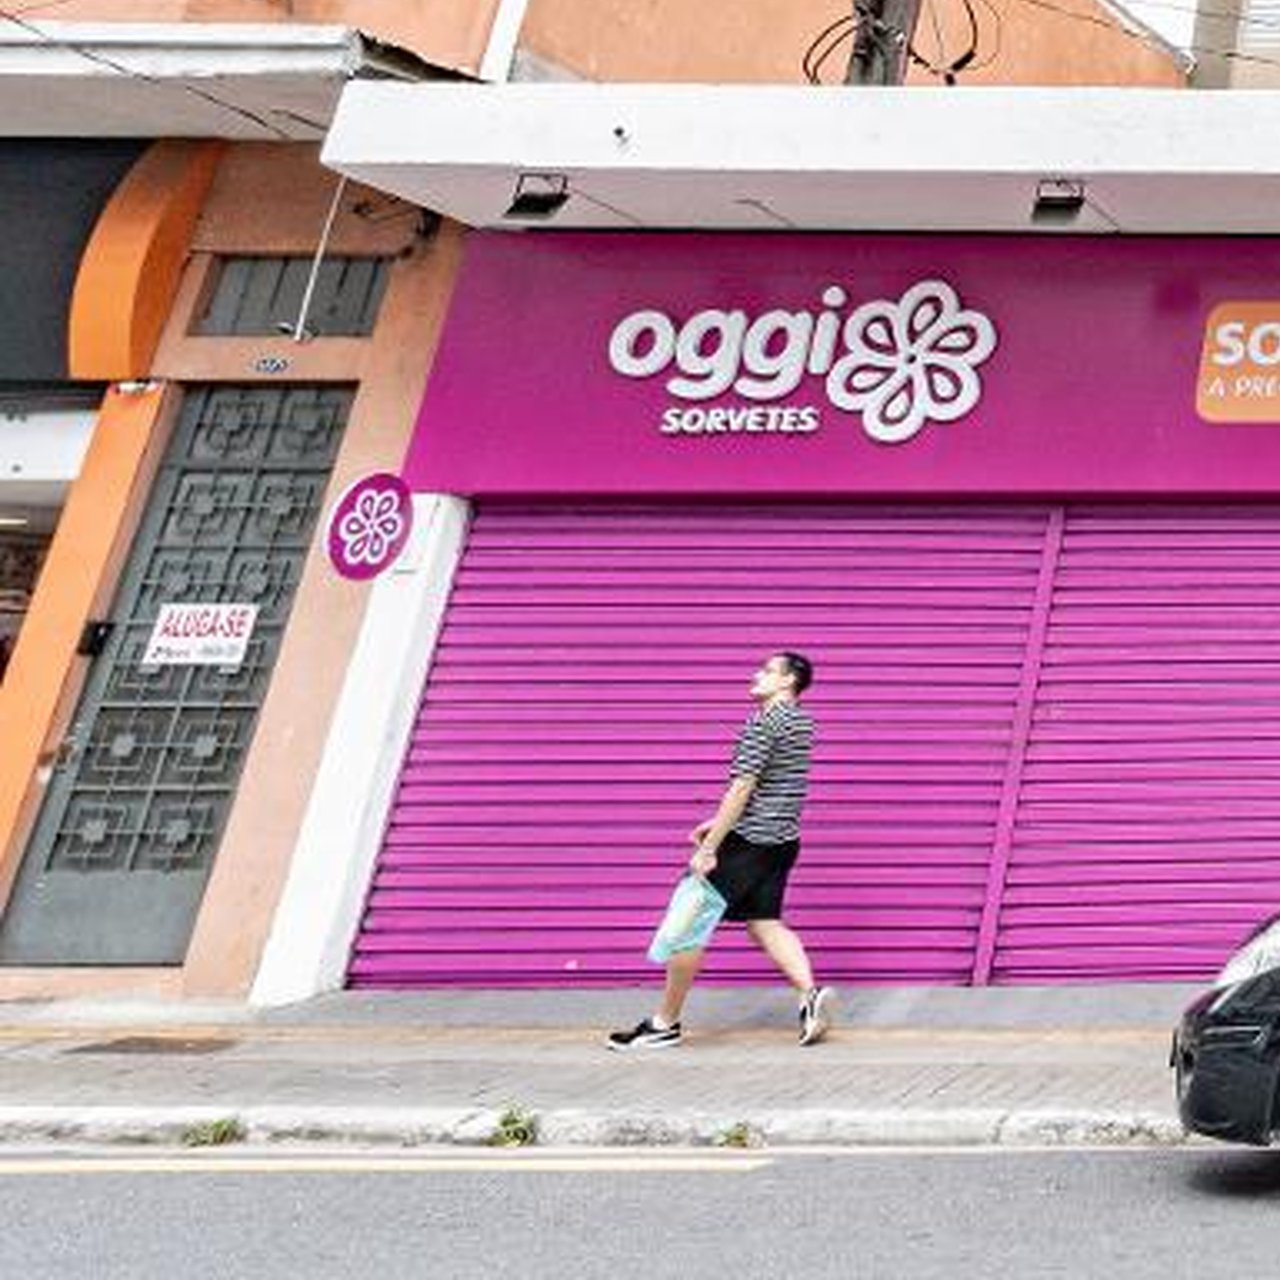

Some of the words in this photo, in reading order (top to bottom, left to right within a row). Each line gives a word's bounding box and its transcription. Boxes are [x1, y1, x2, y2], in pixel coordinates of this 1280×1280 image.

[609, 285, 847, 400] oggi
[1208, 377, 1225, 397] A
[659, 406, 820, 434] SORVETES
